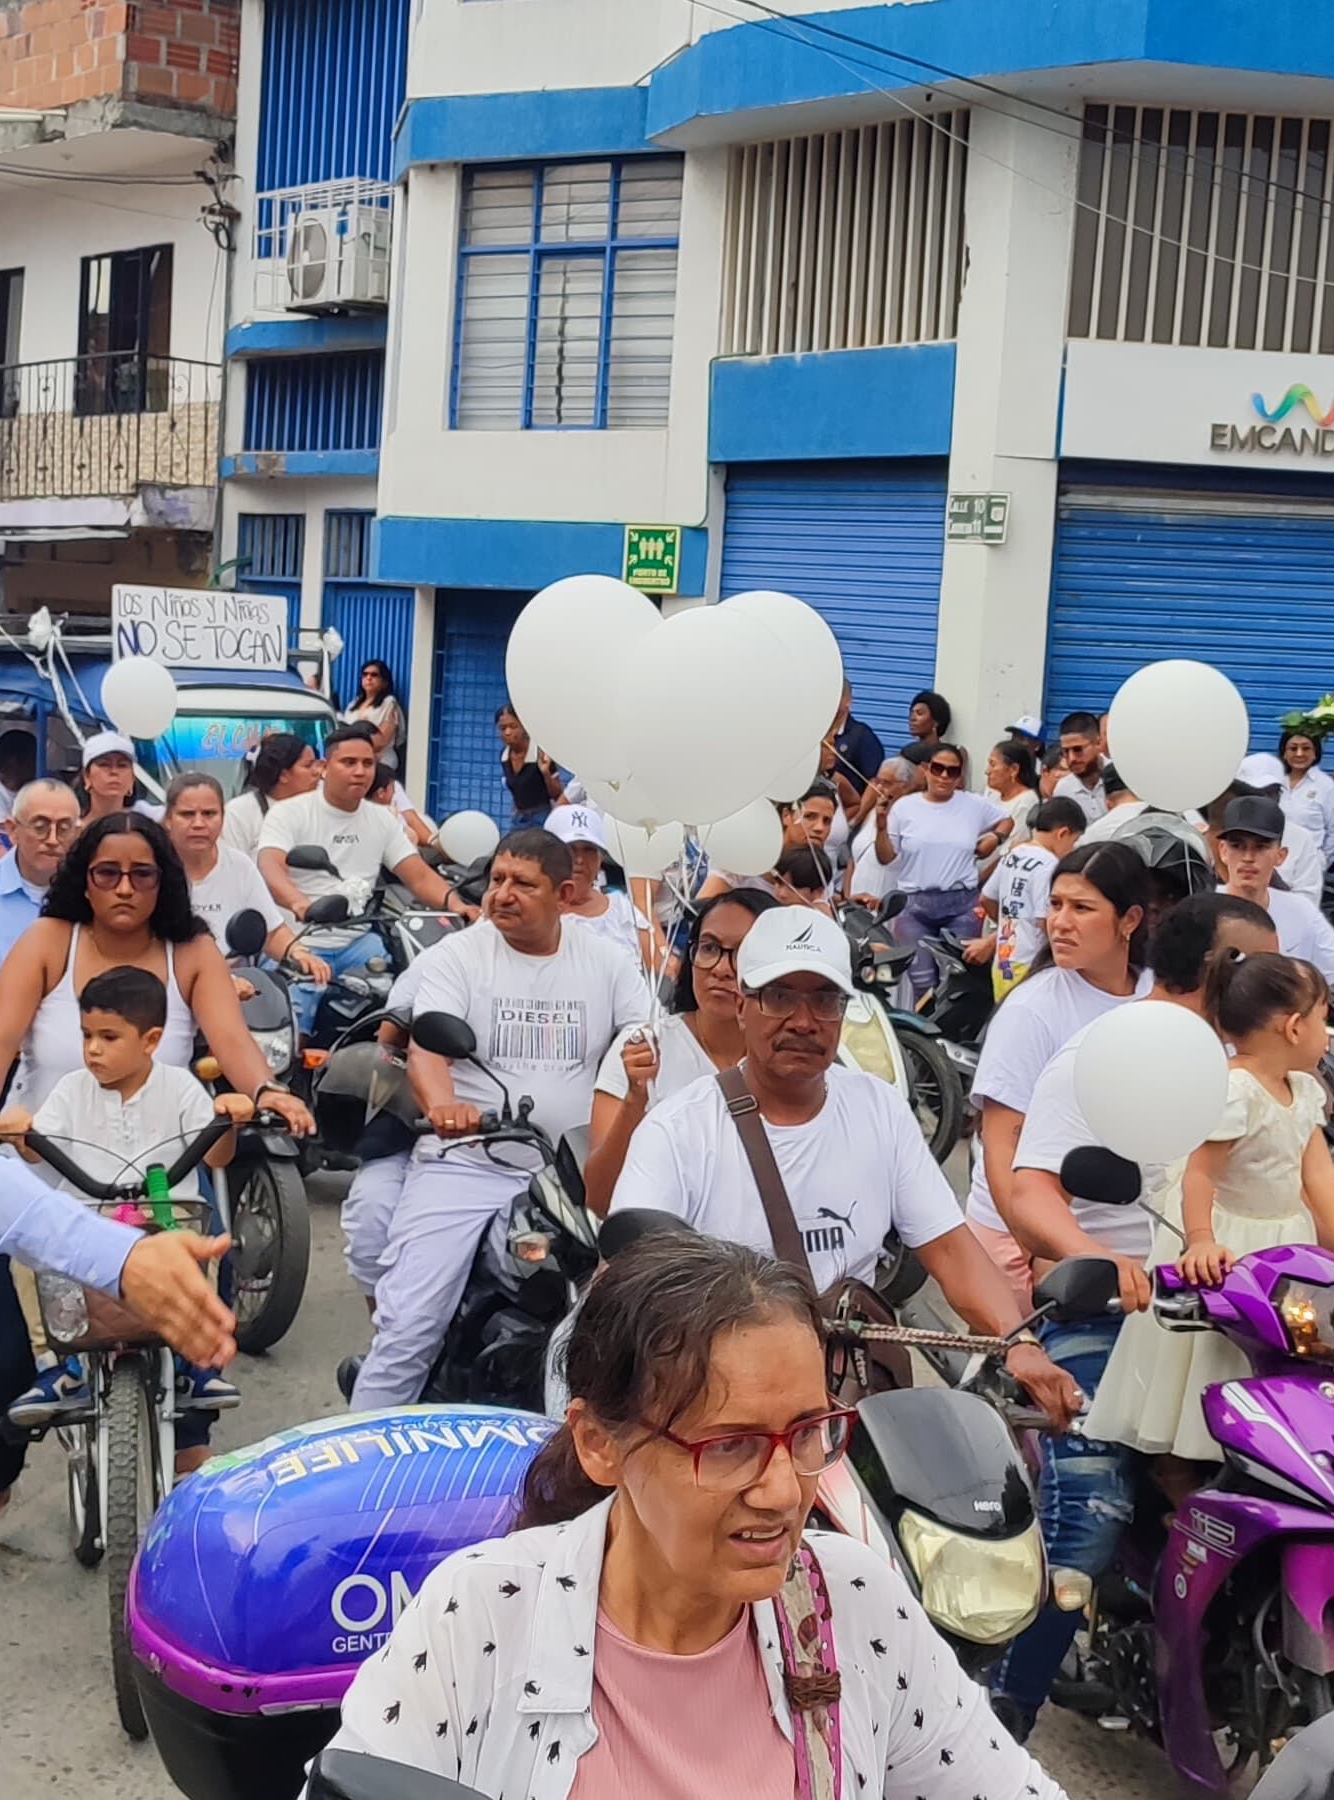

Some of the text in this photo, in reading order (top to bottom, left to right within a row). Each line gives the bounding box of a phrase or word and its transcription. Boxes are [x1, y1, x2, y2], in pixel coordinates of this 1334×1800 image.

[117, 619, 283, 665] NO SE TOCAN
[500, 1009, 579, 1024] DIESEL
[799, 1226, 845, 1253] MA
